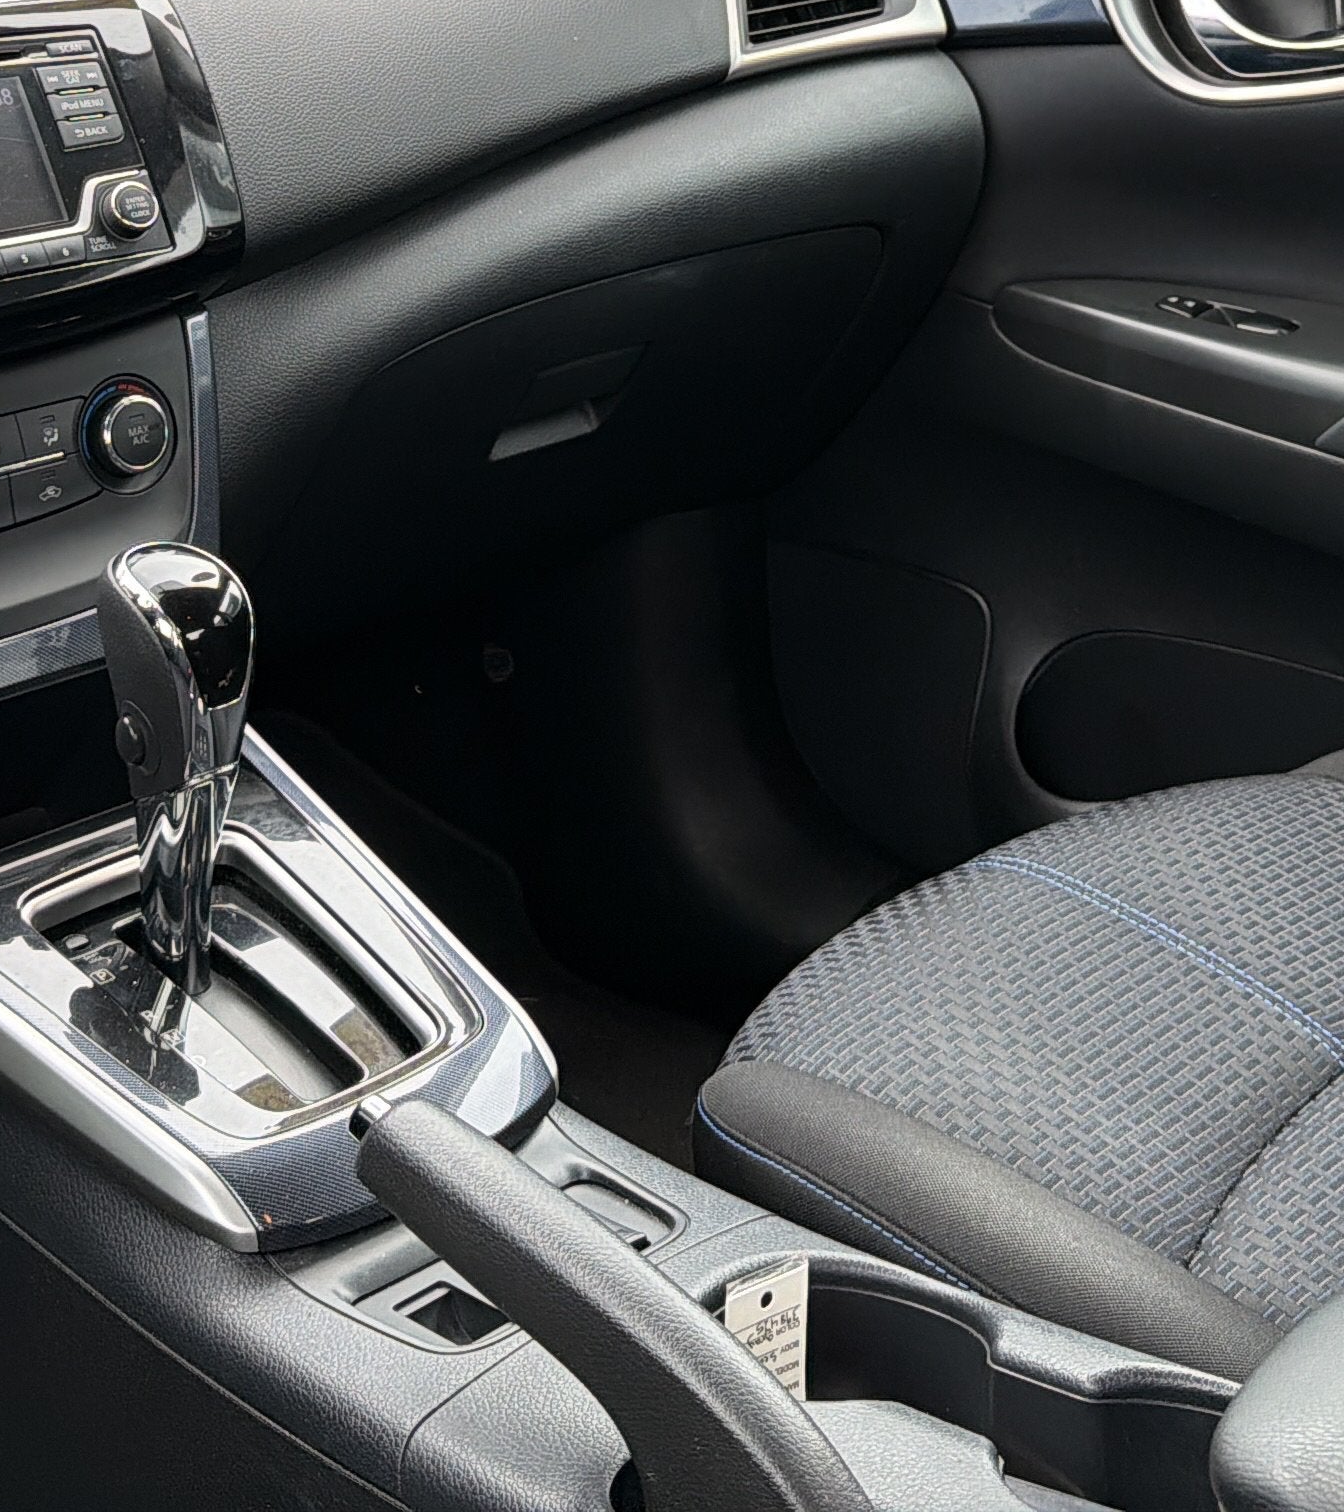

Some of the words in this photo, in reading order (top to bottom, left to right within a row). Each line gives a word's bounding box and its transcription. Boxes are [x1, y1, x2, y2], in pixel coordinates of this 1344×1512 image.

[59, 42, 82, 53] SCAN
[80, 97, 104, 109] MENU
[85, 125, 108, 136] BACK
[128, 424, 150, 437] MAX
[133, 433, 151, 446] A/C
[780, 1340, 800, 1354] BODY
